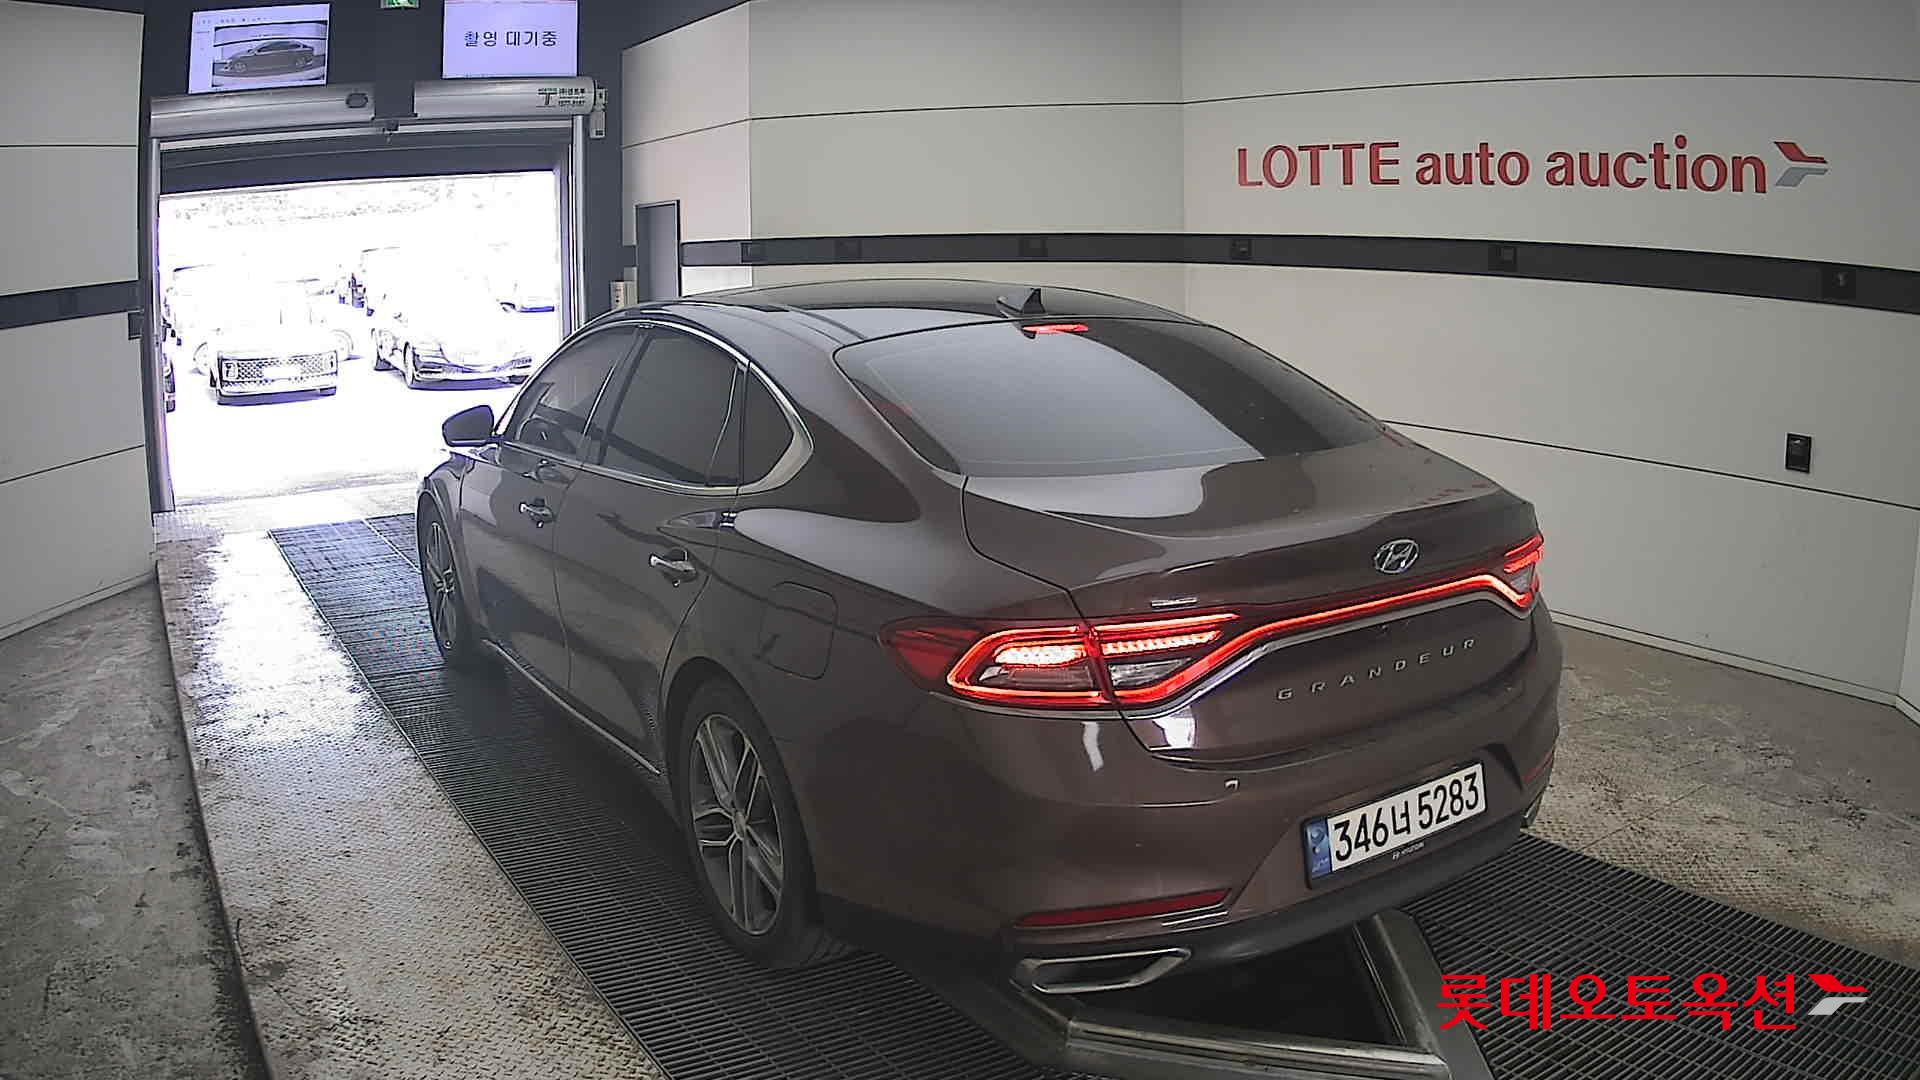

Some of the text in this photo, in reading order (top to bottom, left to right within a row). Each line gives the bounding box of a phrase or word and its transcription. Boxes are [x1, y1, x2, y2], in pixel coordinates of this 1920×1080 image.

[506, 30, 558, 47] 대기중
[1238, 134, 1768, 194] LOTTE auto auction
[1277, 639, 1475, 700] GRANDEUR
[1334, 772, 1479, 861] 346너 5283
